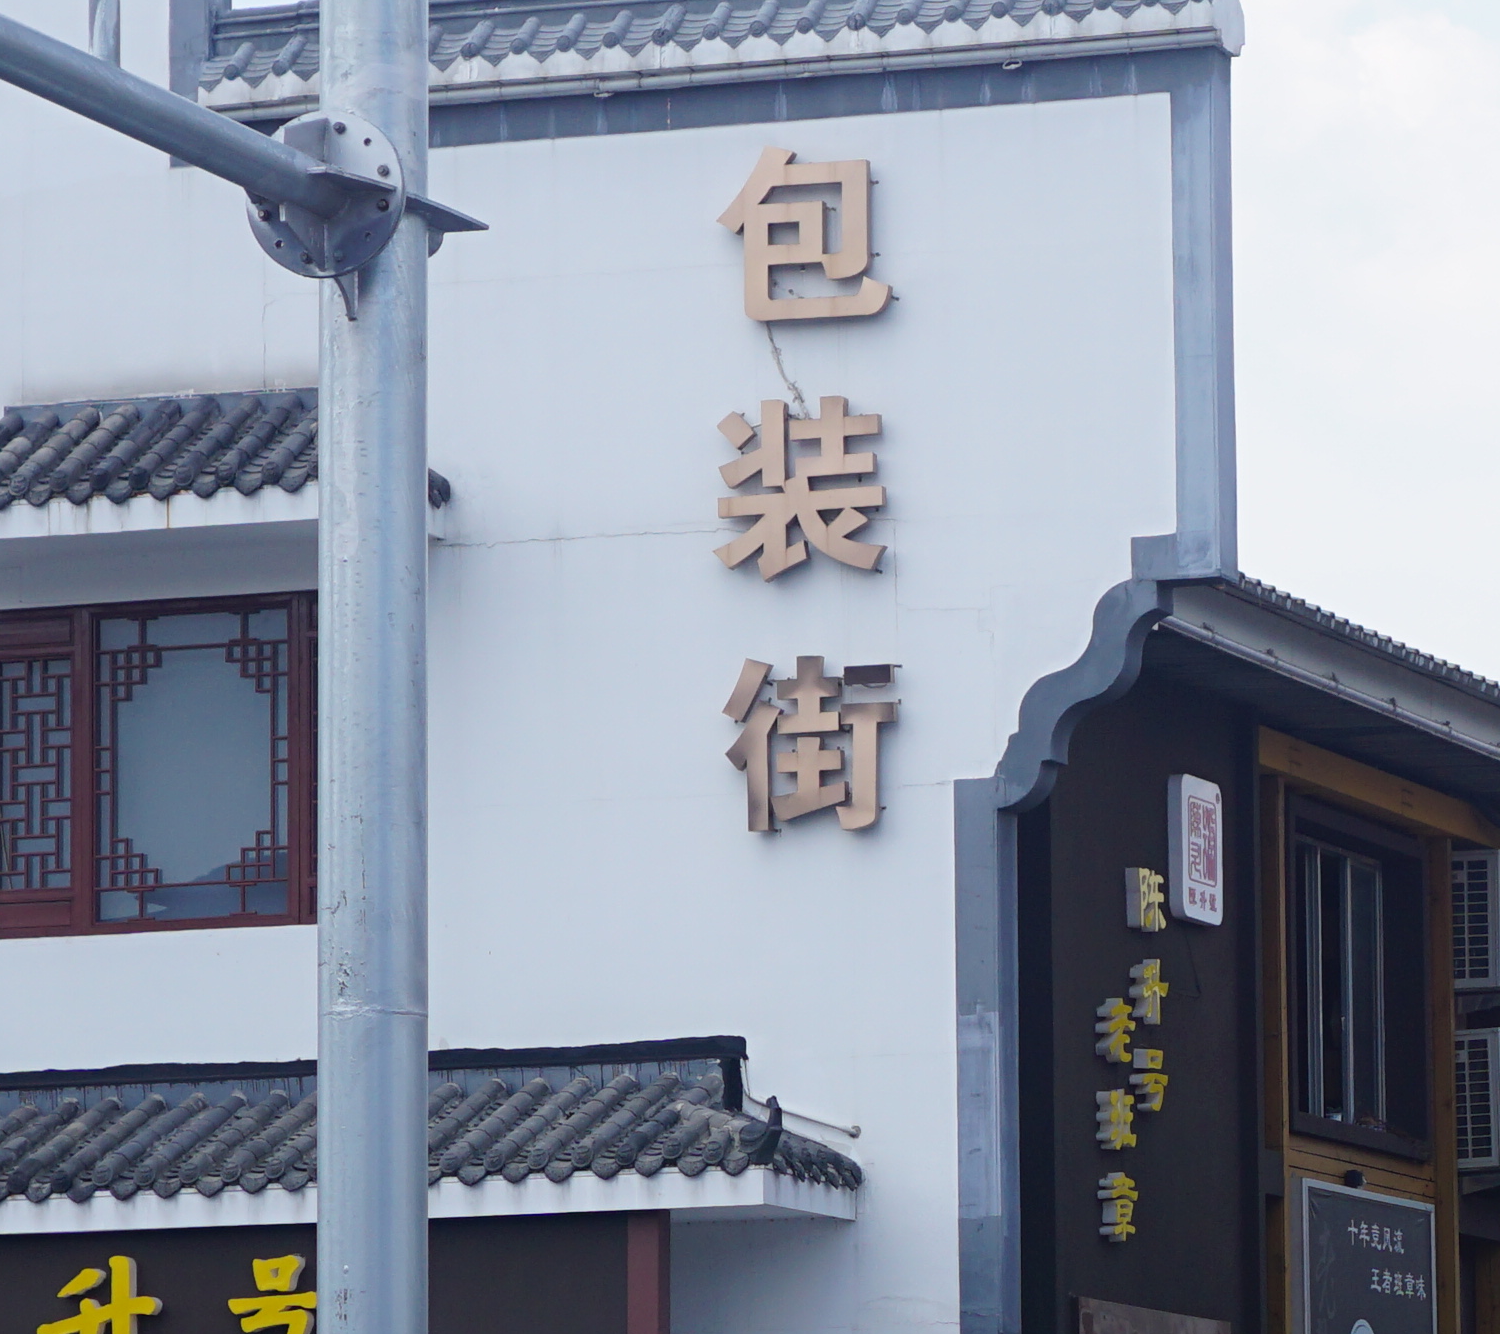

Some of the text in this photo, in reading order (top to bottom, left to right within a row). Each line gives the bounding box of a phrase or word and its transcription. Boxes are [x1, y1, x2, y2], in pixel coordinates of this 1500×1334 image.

[713, 147, 898, 833] 包装街
[1097, 998, 1139, 1243] 老班章
